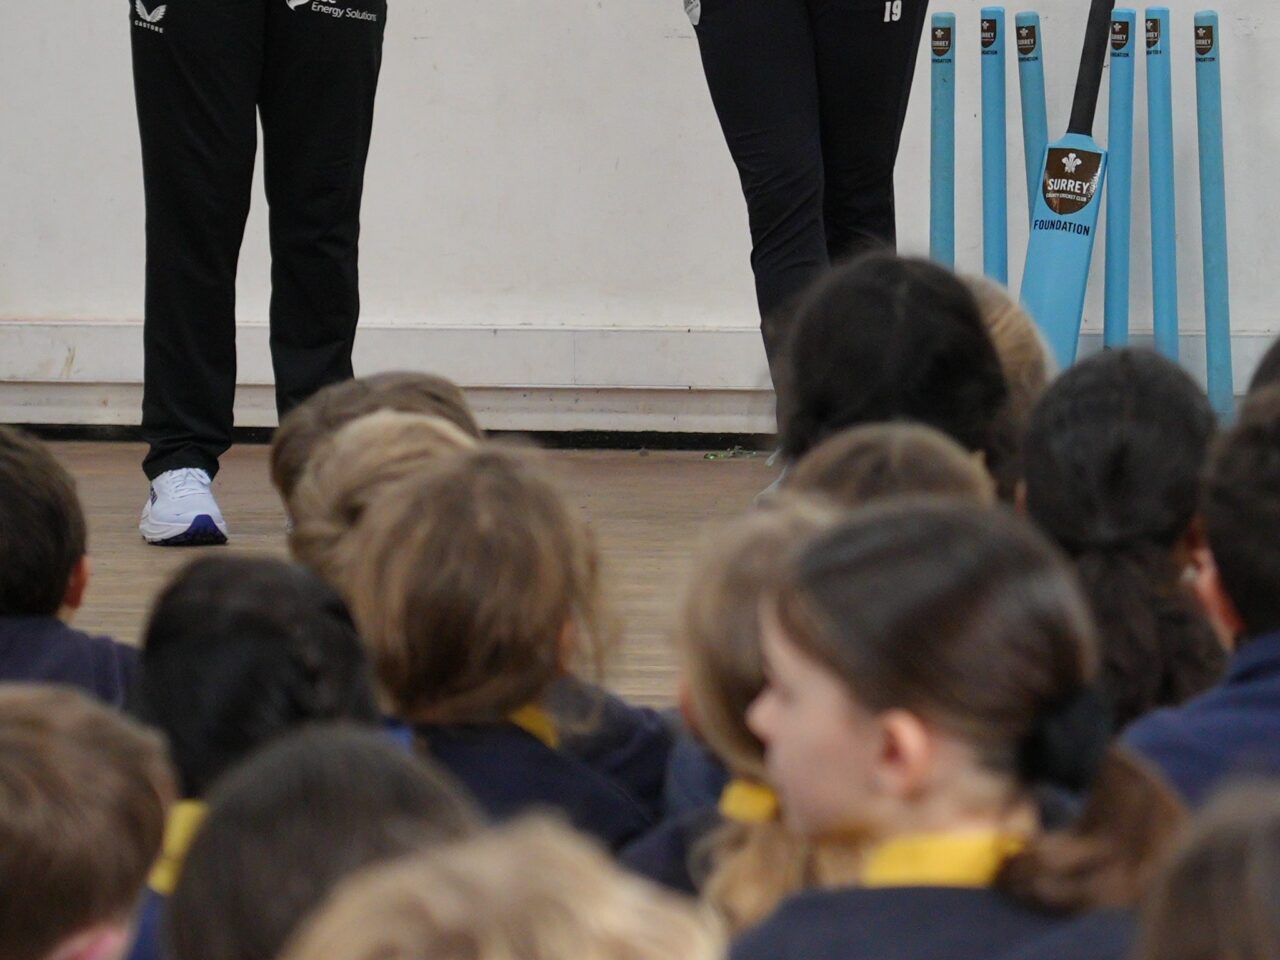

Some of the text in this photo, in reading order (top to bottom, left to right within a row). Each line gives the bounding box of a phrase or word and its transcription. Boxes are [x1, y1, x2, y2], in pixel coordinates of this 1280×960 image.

[311, 1, 345, 19] Energy
[883, 0, 903, 23] 19
[1047, 178, 1090, 194] SURREY
[1033, 219, 1090, 236] FOUNDATION
